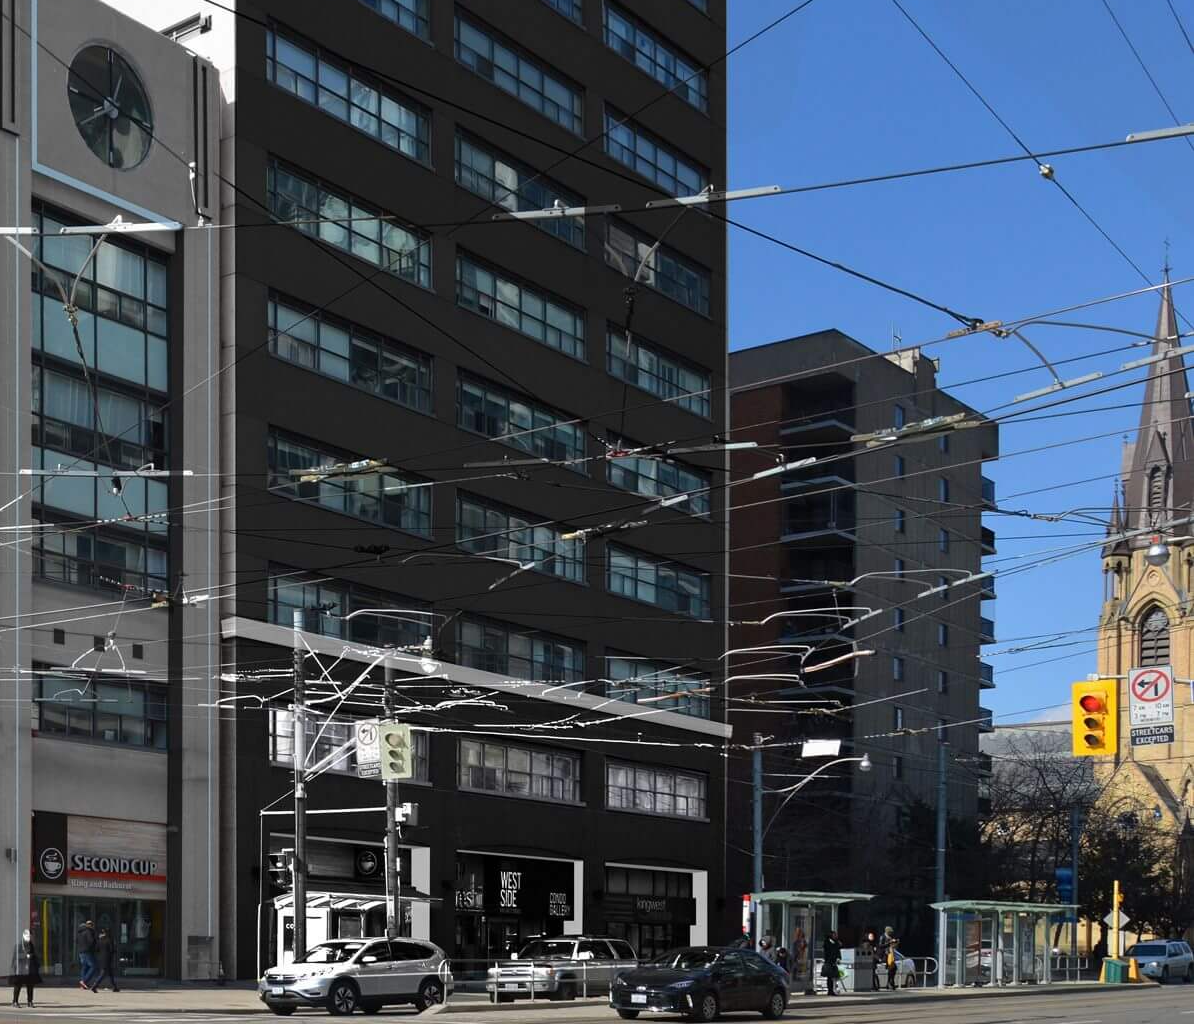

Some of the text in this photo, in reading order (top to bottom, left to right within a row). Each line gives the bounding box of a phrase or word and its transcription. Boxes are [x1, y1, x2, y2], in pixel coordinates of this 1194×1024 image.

[1131, 727, 1173, 736] STREETCARS
[1136, 736, 1169, 744] EXCEPTED
[73, 855, 158, 875] SECOND CUP
[500, 871, 522, 890] WEST
[500, 889, 517, 907] SIDE
[549, 892, 567, 904] CONDO
